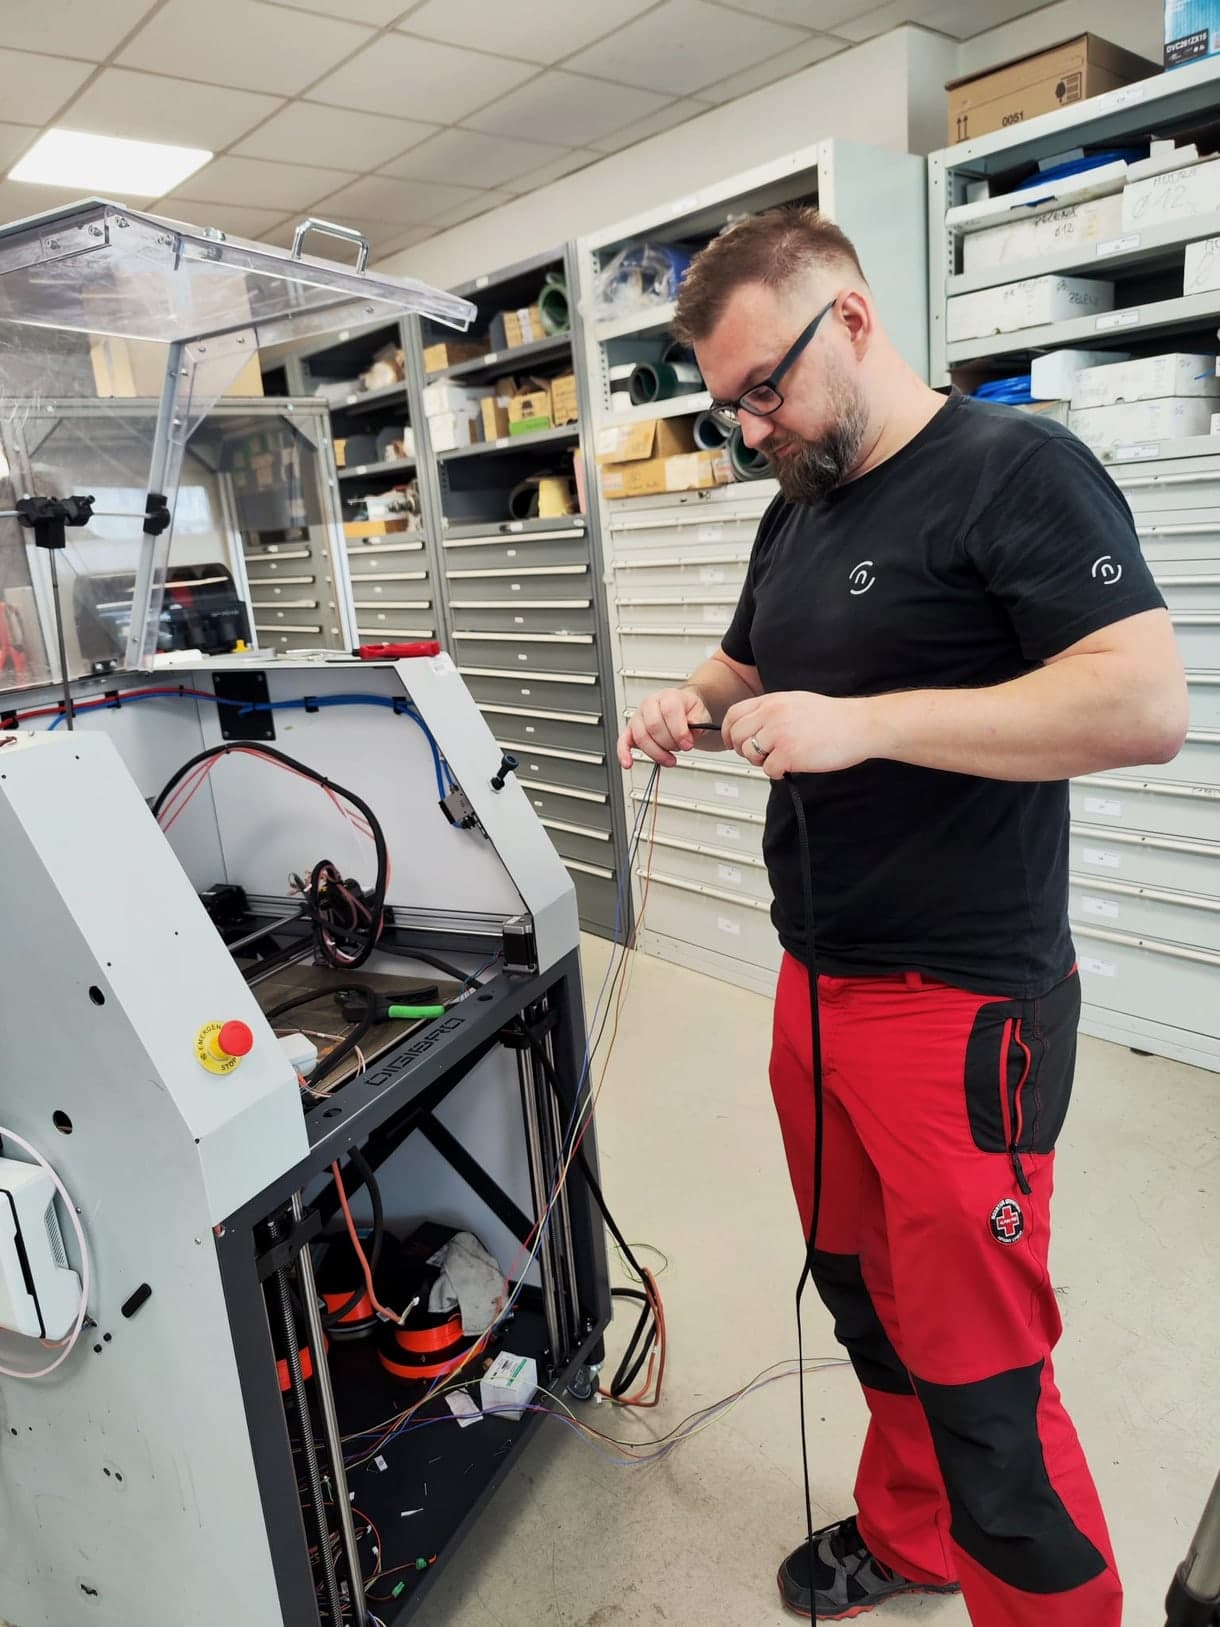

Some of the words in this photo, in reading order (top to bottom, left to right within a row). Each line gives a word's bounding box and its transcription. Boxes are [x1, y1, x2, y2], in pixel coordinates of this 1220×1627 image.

[1002, 110, 1024, 127] 0051
[197, 1023, 222, 1051] EMERGEN
[364, 1016, 466, 1087] DIGIBRO
[220, 1056, 238, 1071] STOP
